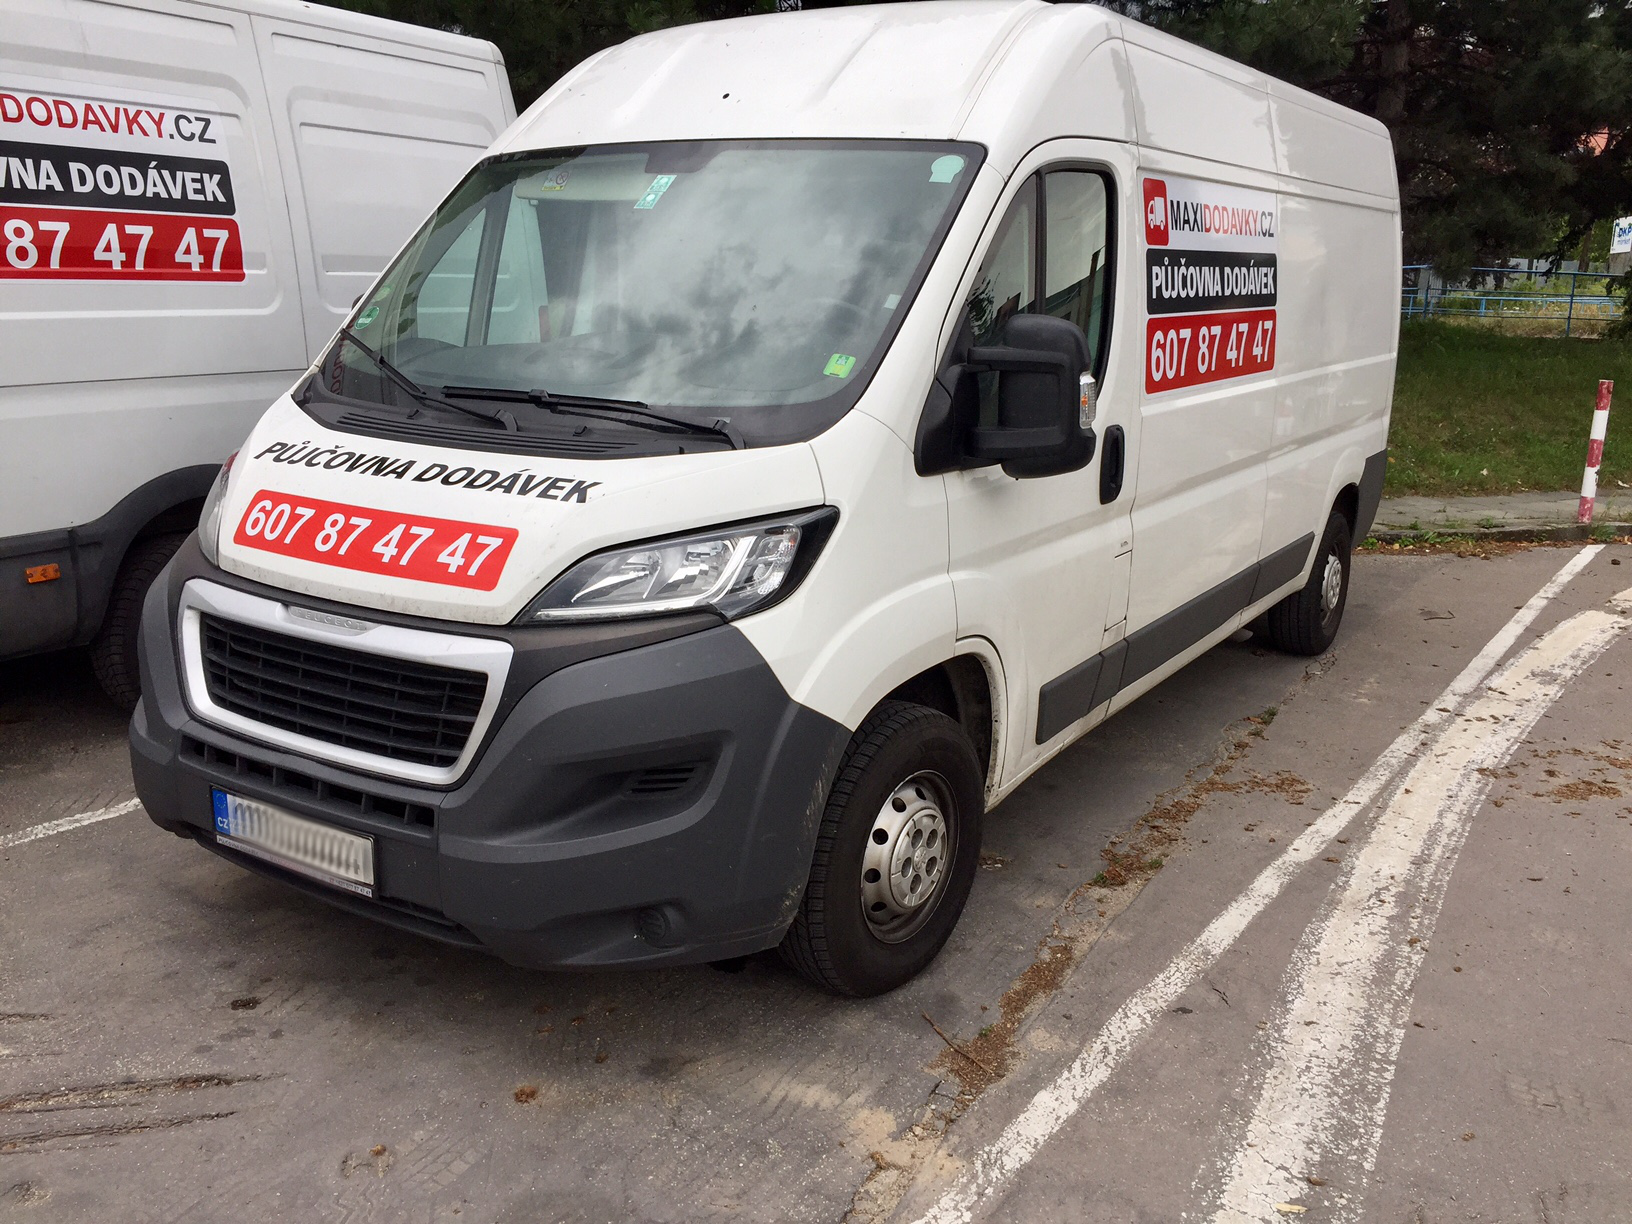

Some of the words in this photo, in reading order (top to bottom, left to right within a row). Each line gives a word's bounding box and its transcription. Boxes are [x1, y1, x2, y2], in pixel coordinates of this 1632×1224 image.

[68, 161, 227, 203] DODÁVEK
[1170, 199, 1275, 238] MAXIDODAVKY.CZ
[3, 218, 71, 269] 87
[93, 223, 154, 270] 47
[174, 227, 229, 272] 47
[1152, 257, 1222, 299] PŮJČOVNA
[1224, 260, 1275, 296] DODÁVEK
[1151, 328, 1191, 382] 607
[1197, 325, 1222, 374] 87
[1226, 322, 1249, 368] 47
[1252, 320, 1274, 363] 47
[253, 440, 413, 480] PŮJČOVNA
[411, 463, 602, 504] DODÁVEK
[244, 499, 315, 545] 607
[313, 512, 372, 556] 87
[372, 523, 435, 566] 47
[436, 533, 503, 576] 47
[217, 816, 229, 829] CZ
